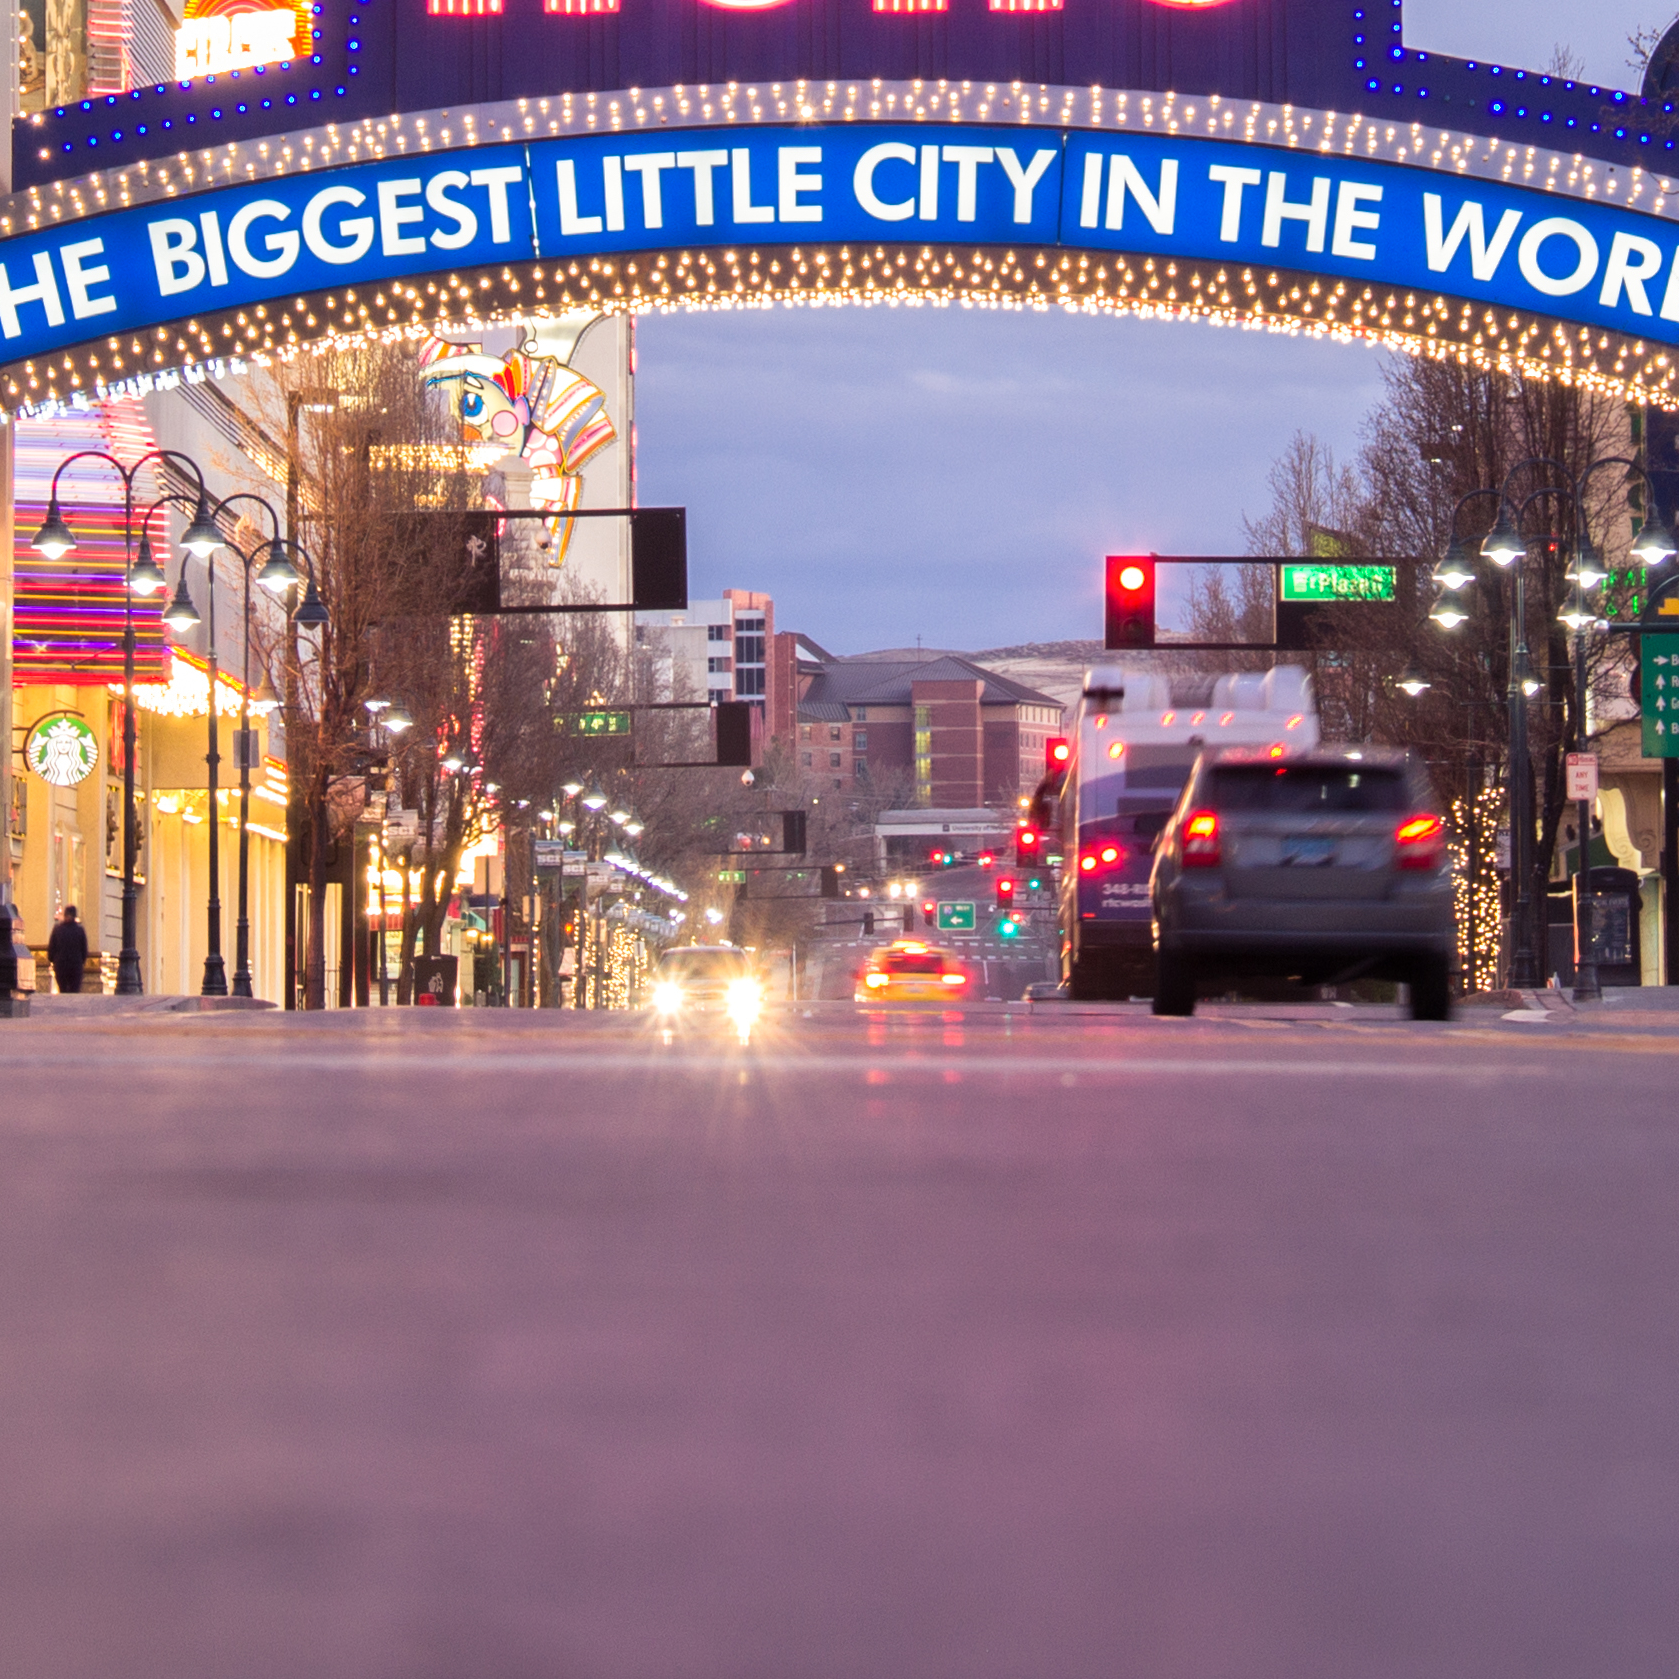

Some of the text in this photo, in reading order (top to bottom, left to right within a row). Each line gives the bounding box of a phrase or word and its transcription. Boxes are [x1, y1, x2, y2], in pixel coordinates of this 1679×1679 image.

[146, 164, 524, 297] BIGGEST
[554, 146, 823, 237] LITTLE
[853, 144, 1060, 225] CITY
[1079, 152, 1182, 237] IN
[1208, 164, 1386, 261] THE
